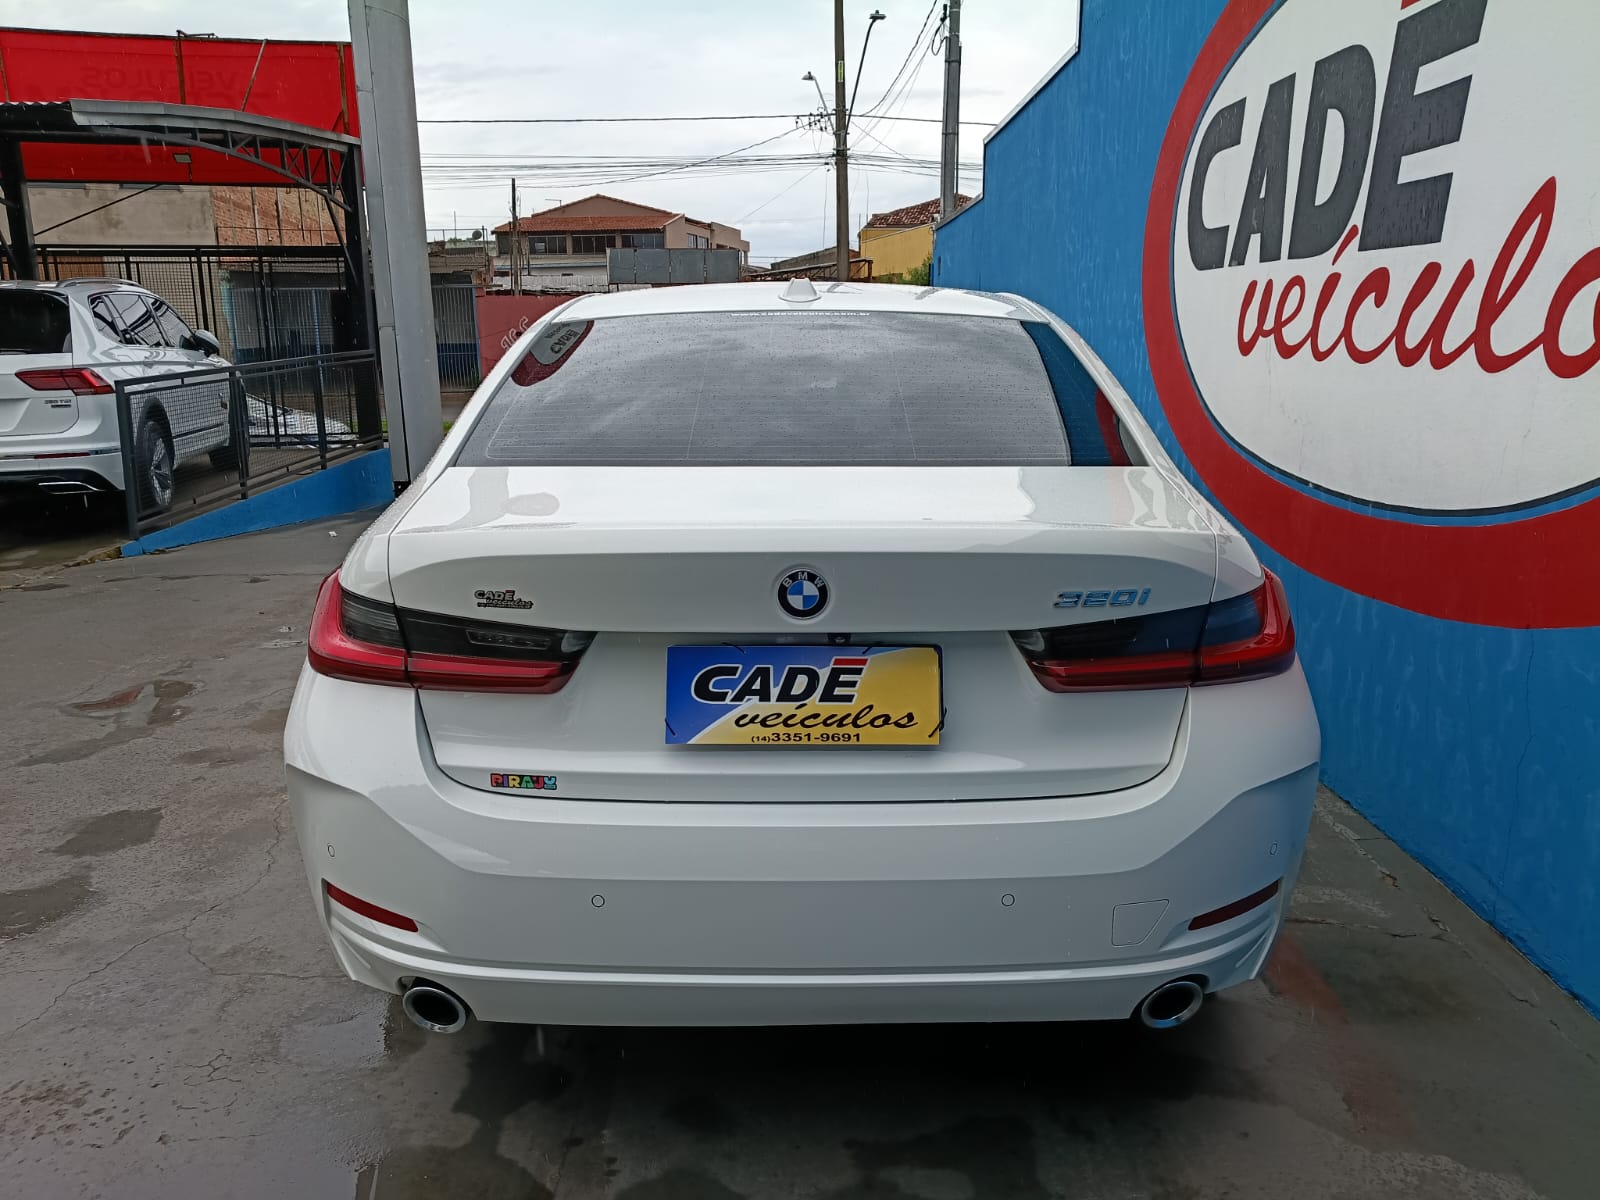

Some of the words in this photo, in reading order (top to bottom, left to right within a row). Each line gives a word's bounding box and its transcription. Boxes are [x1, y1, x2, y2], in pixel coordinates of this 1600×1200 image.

[782, 571, 824, 588] BMW
[1053, 588, 1151, 608] 320i
[751, 732, 860, 743] (14)3351-9691
[490, 773, 557, 790] PIRAJU
